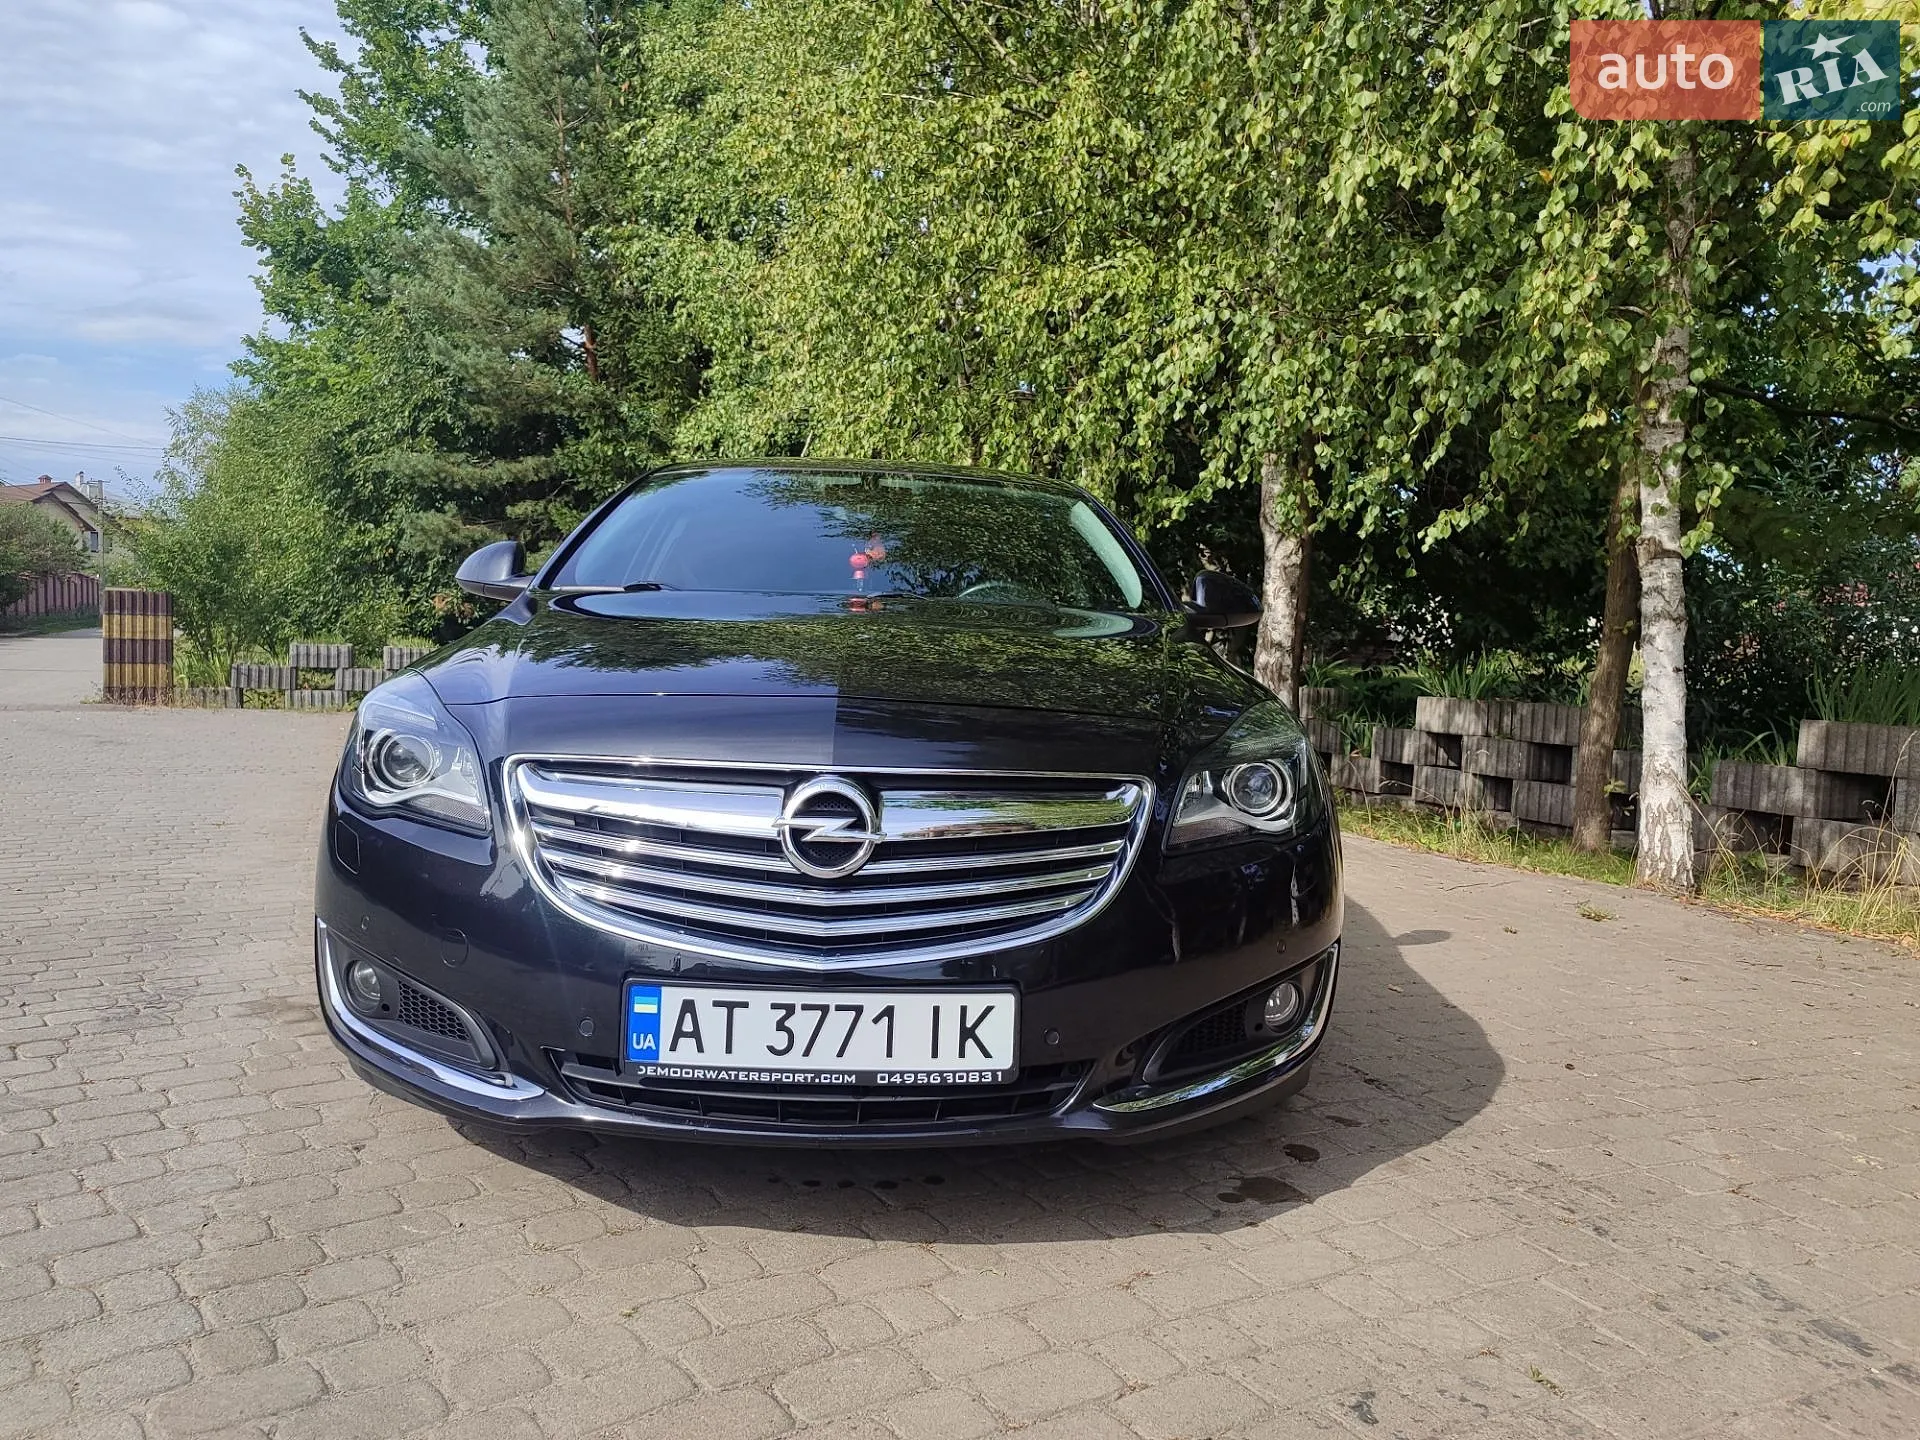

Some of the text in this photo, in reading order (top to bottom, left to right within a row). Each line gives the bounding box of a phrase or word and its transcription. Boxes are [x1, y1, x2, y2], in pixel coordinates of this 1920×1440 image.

[632, 1033, 656, 1050] UA
[669, 999, 996, 1058] AT 3771 IK
